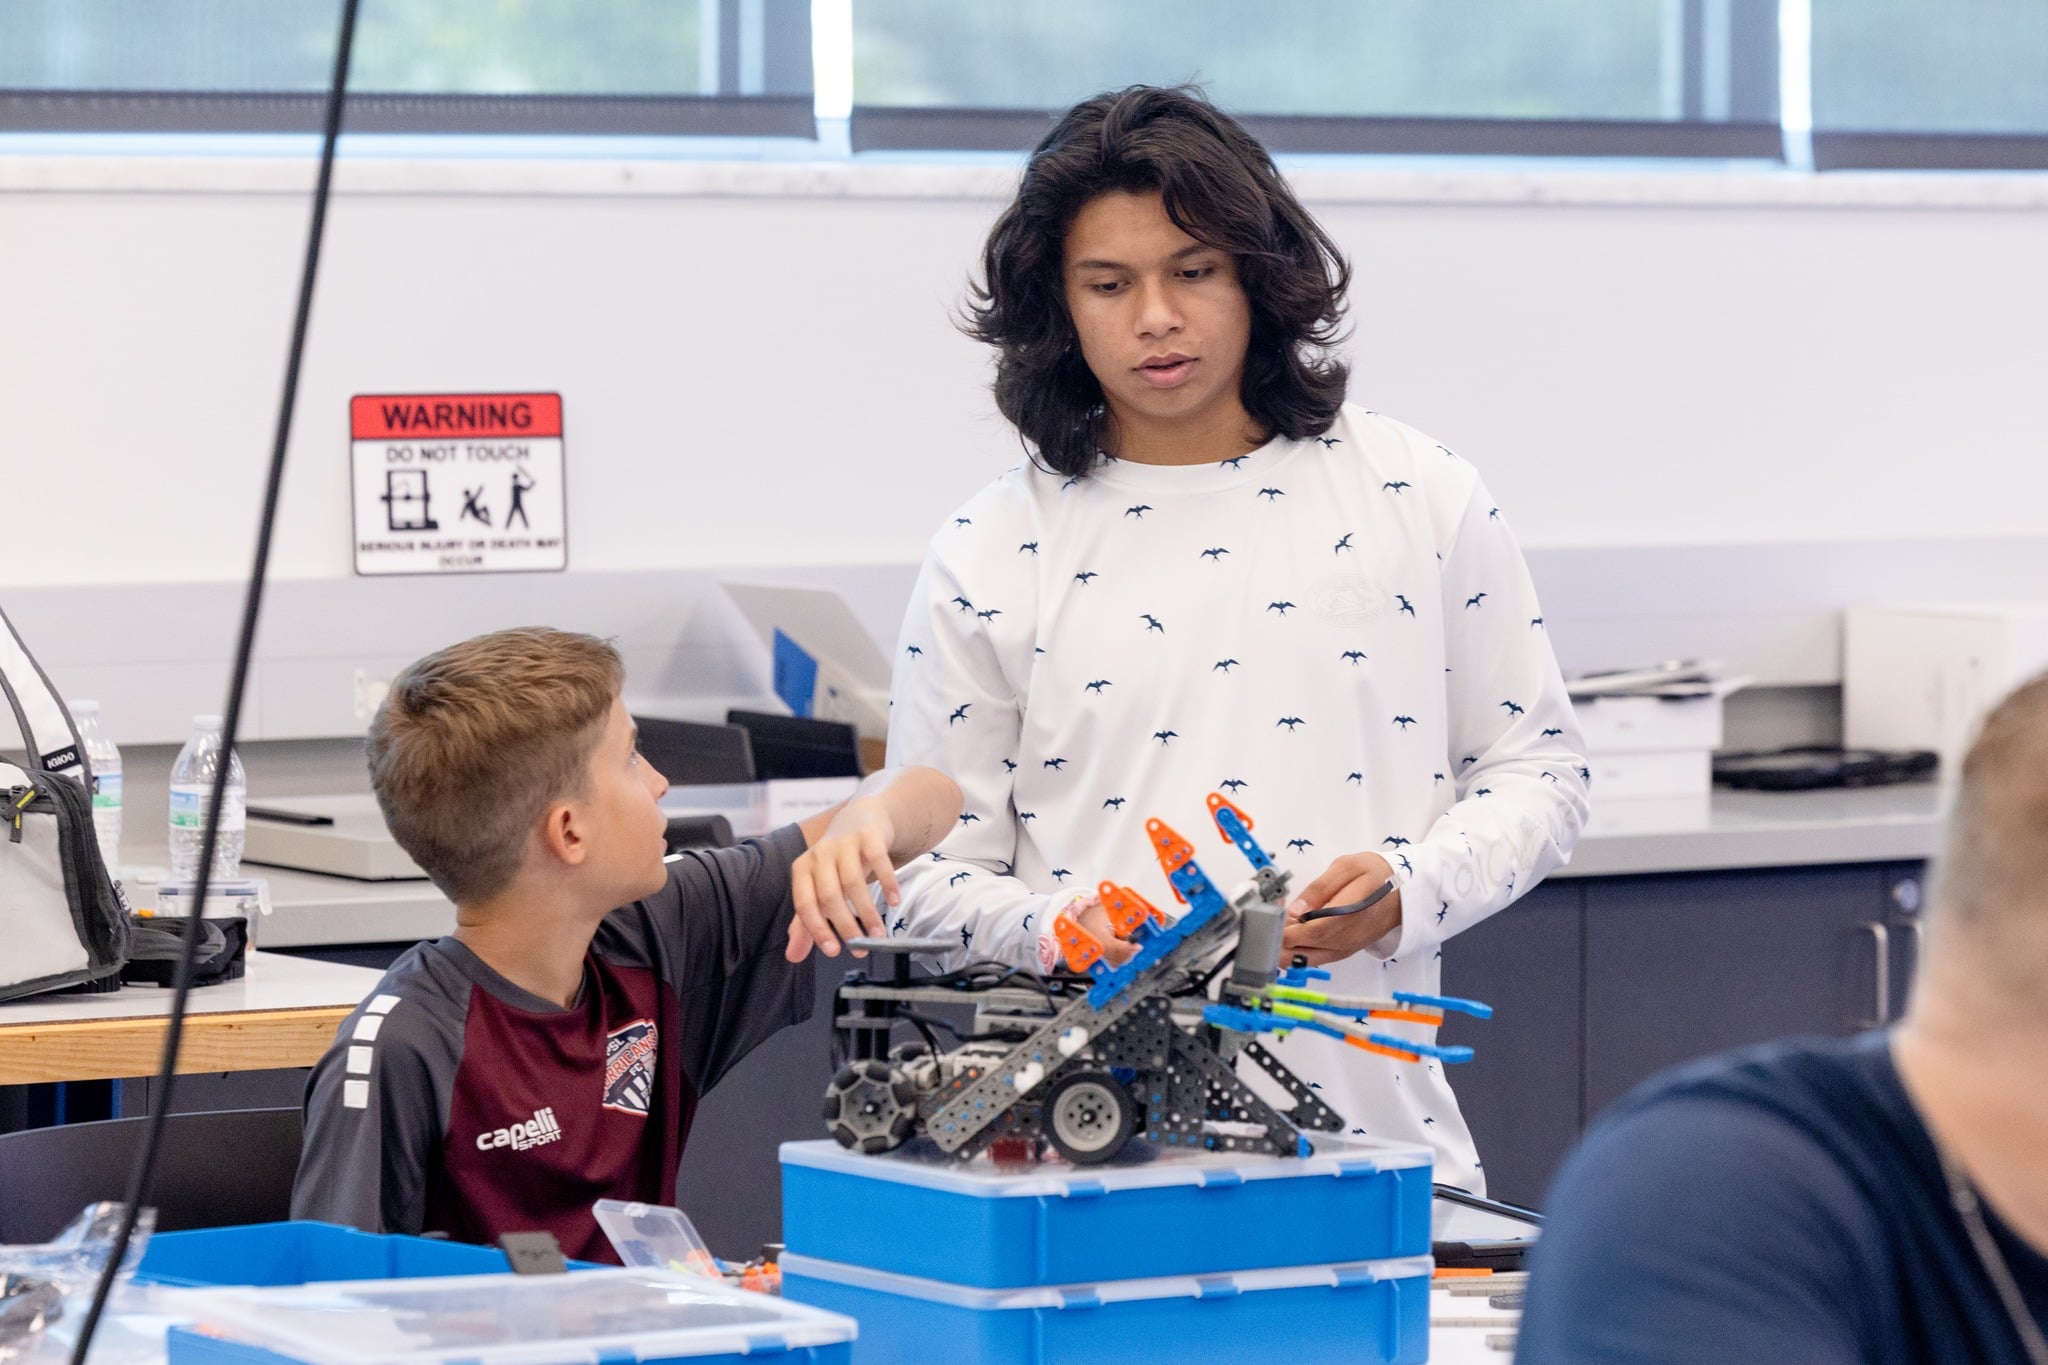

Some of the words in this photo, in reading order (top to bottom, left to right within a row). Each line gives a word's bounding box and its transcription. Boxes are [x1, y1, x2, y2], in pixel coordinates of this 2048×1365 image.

[382, 403, 532, 430] WARNING
[386, 447, 413, 462] DO
[420, 447, 456, 462] NOT
[466, 446, 529, 462] TOUCH
[360, 541, 415, 553] SERIOUS
[421, 540, 463, 552] INJURY
[469, 540, 485, 550] OR
[491, 540, 531, 550] DEATH
[438, 555, 483, 568] OCCUR
[629, 1062, 644, 1076] FC
[476, 1106, 560, 1151] capelli
[518, 1129, 562, 1151] SPORT
